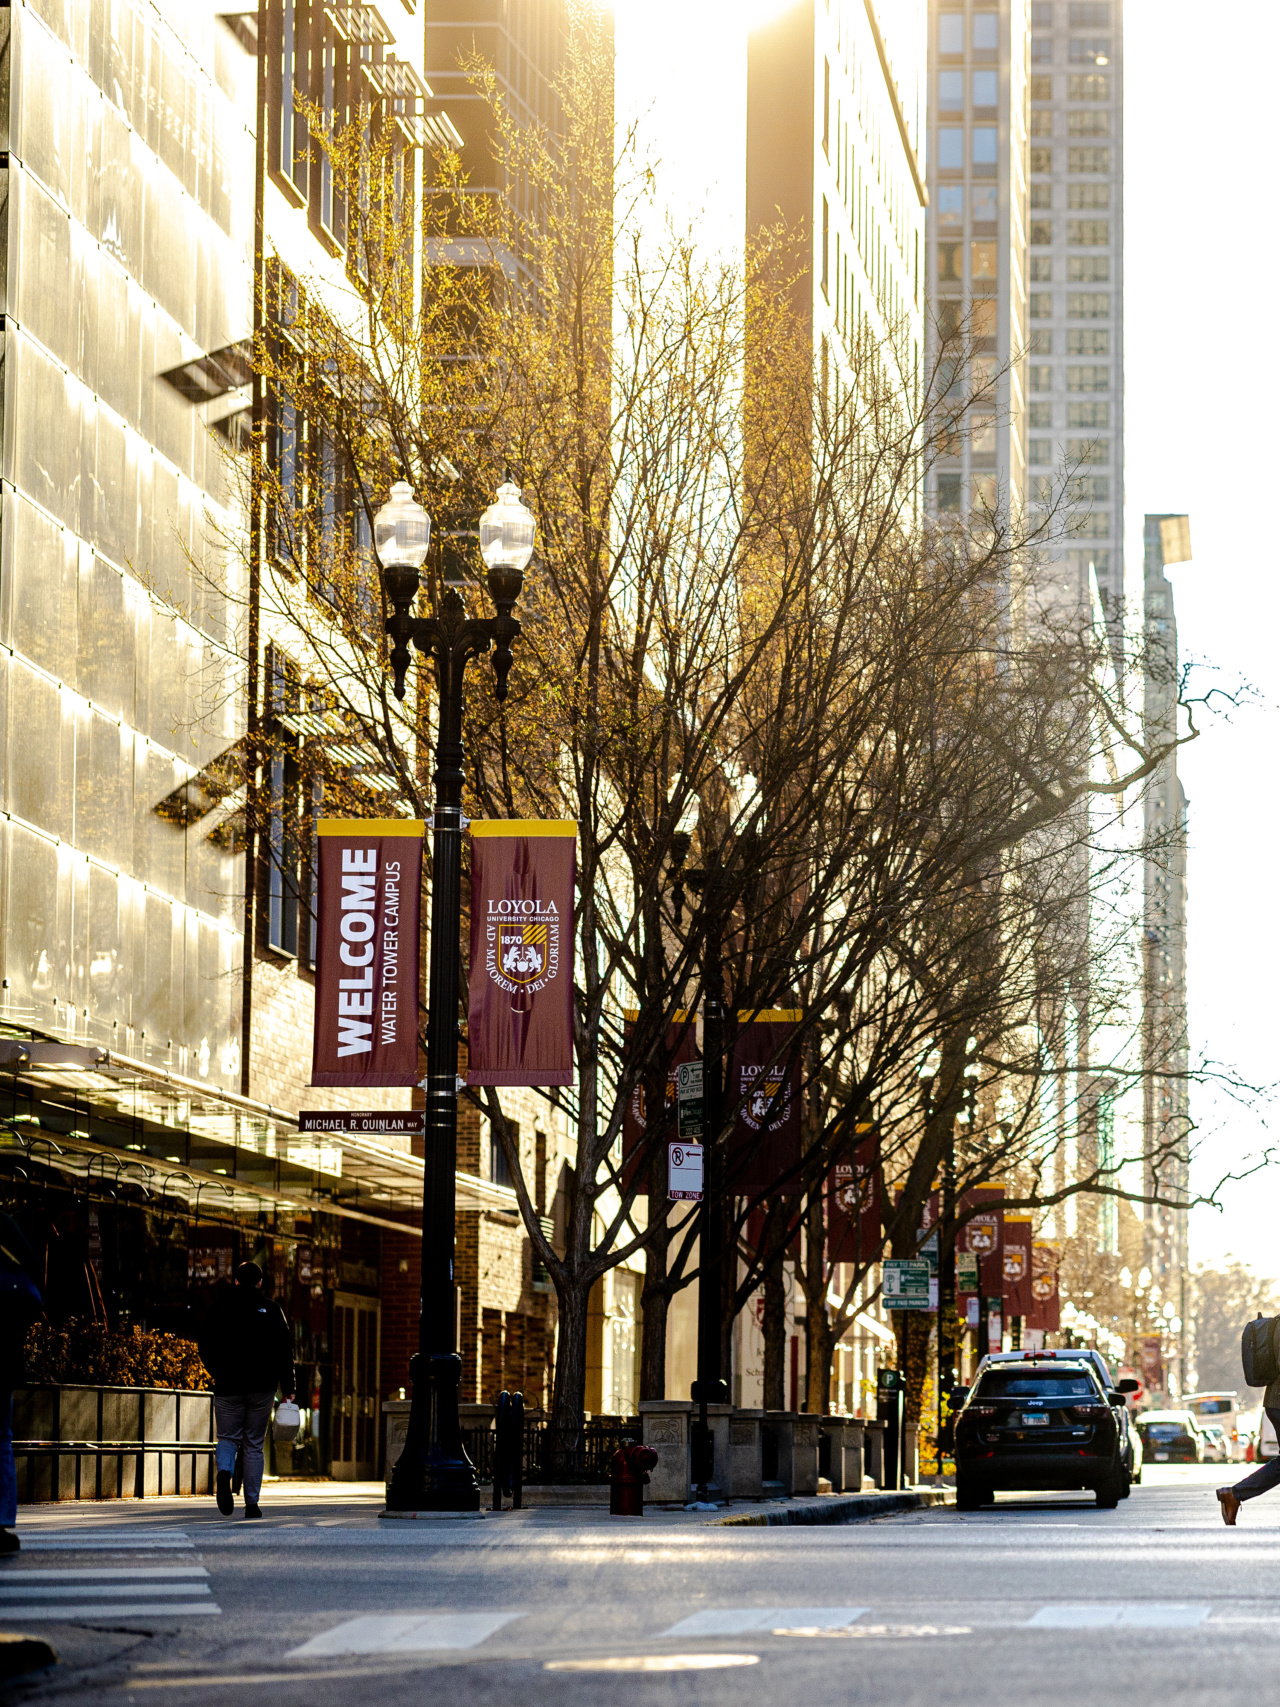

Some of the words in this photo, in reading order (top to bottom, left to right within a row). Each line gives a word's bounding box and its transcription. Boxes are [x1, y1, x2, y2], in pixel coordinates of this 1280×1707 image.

[384, 861, 400, 926] CAMPUS
[487, 900, 559, 914] LOYOLA
[337, 848, 377, 1058] WELCOME
[382, 931, 398, 987] TOWER
[486, 948, 518, 994] MAJOREM
[526, 978, 546, 994] DEI
[547, 924, 559, 978] GLORIAM
[500, 936, 522, 944] 1870
[381, 991, 396, 1045] WATER
[305, 1120, 347, 1130] MICHAEL
[350, 1120, 358, 1130] R.
[362, 1120, 404, 1130] QUINLAN
[685, 1192, 700, 1200] ZONE
